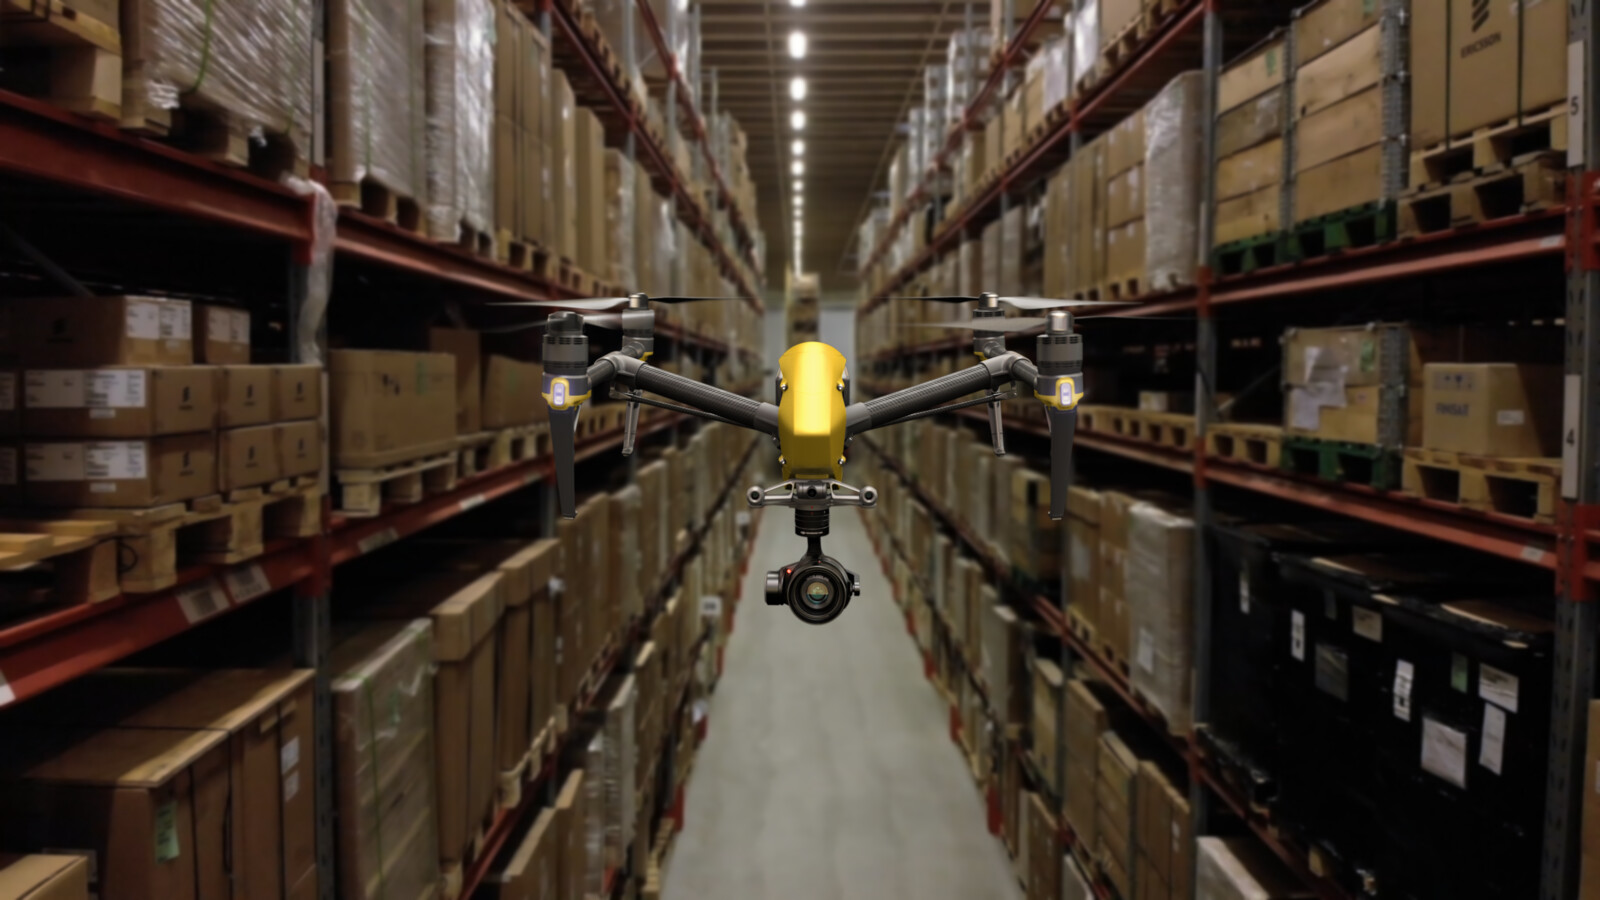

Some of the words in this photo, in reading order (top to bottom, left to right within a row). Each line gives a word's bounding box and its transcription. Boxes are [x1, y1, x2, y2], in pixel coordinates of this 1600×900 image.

[1460, 32, 1501, 58] ERICSSON
[1570, 96, 1579, 116] 5
[1566, 428, 1575, 447] 4
